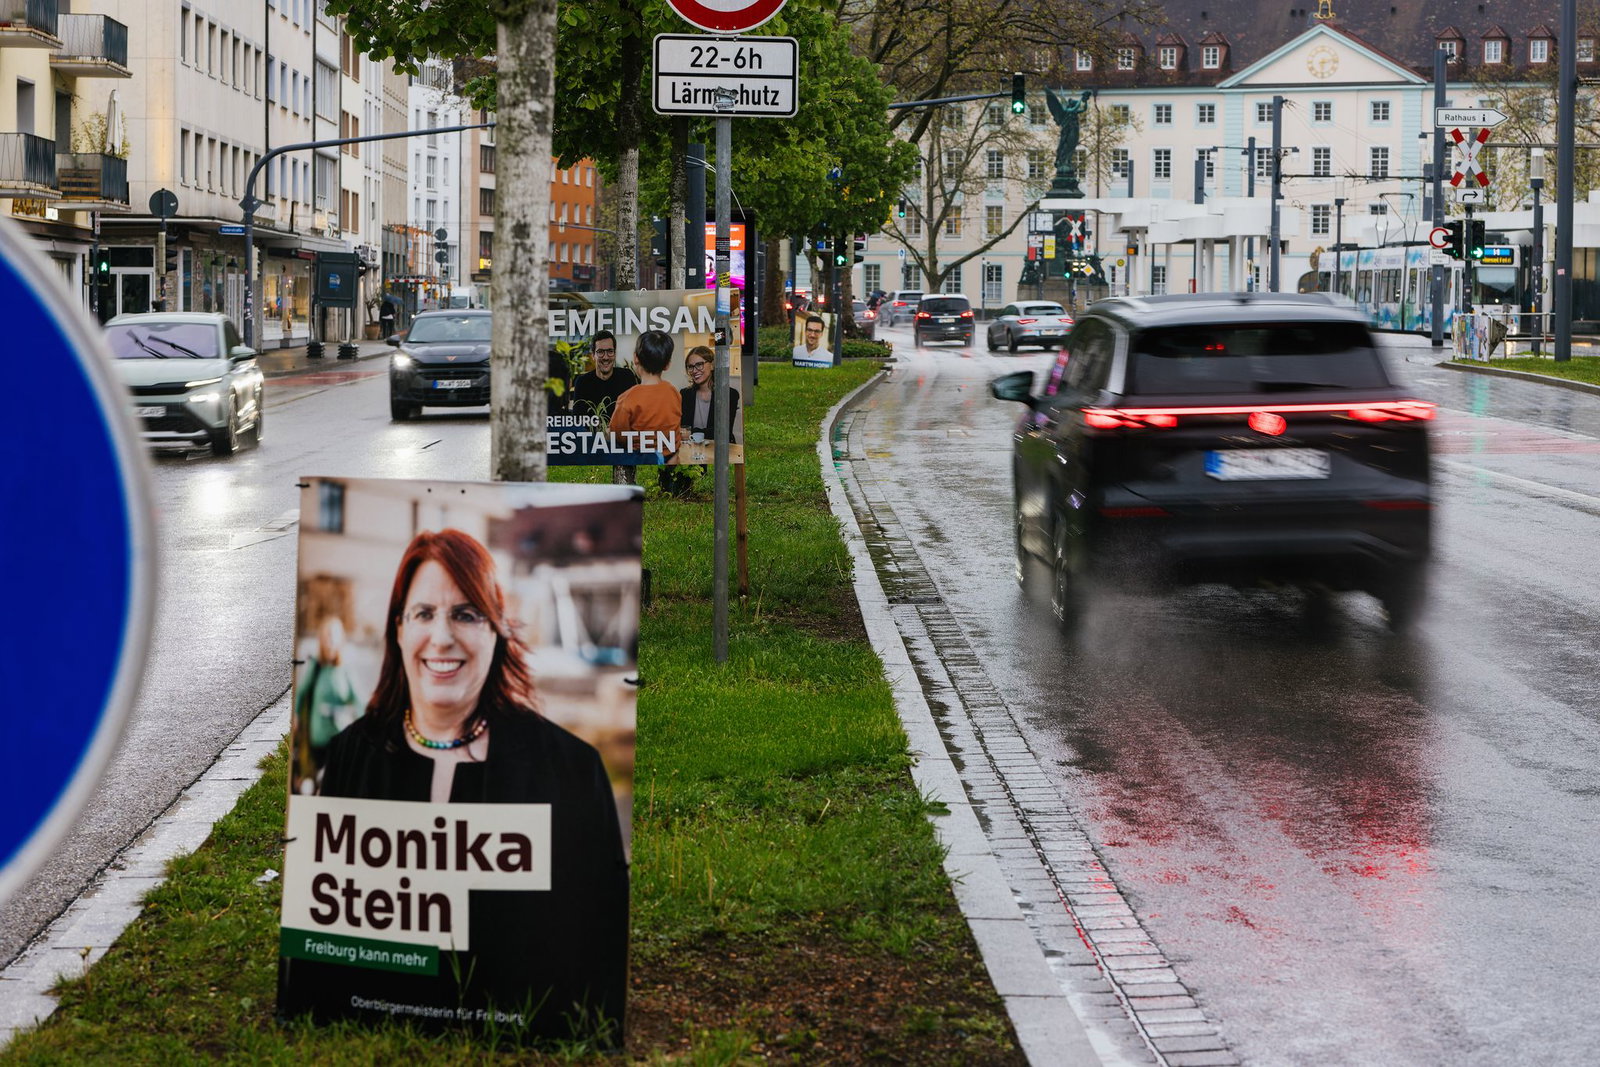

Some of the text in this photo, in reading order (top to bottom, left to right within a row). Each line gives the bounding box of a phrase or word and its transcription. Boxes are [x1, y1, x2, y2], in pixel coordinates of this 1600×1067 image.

[690, 45, 762, 69] 22-6h
[1444, 113, 1476, 122] Rathaus
[548, 305, 716, 337] EMEINSAM
[547, 415, 600, 427] REIBURG
[547, 430, 676, 454] ESTALTEN
[314, 812, 533, 873] Monika
[309, 872, 452, 934] Stein
[304, 938, 428, 967] Freiburg kann mehr
[456, 1006, 473, 1020] für
